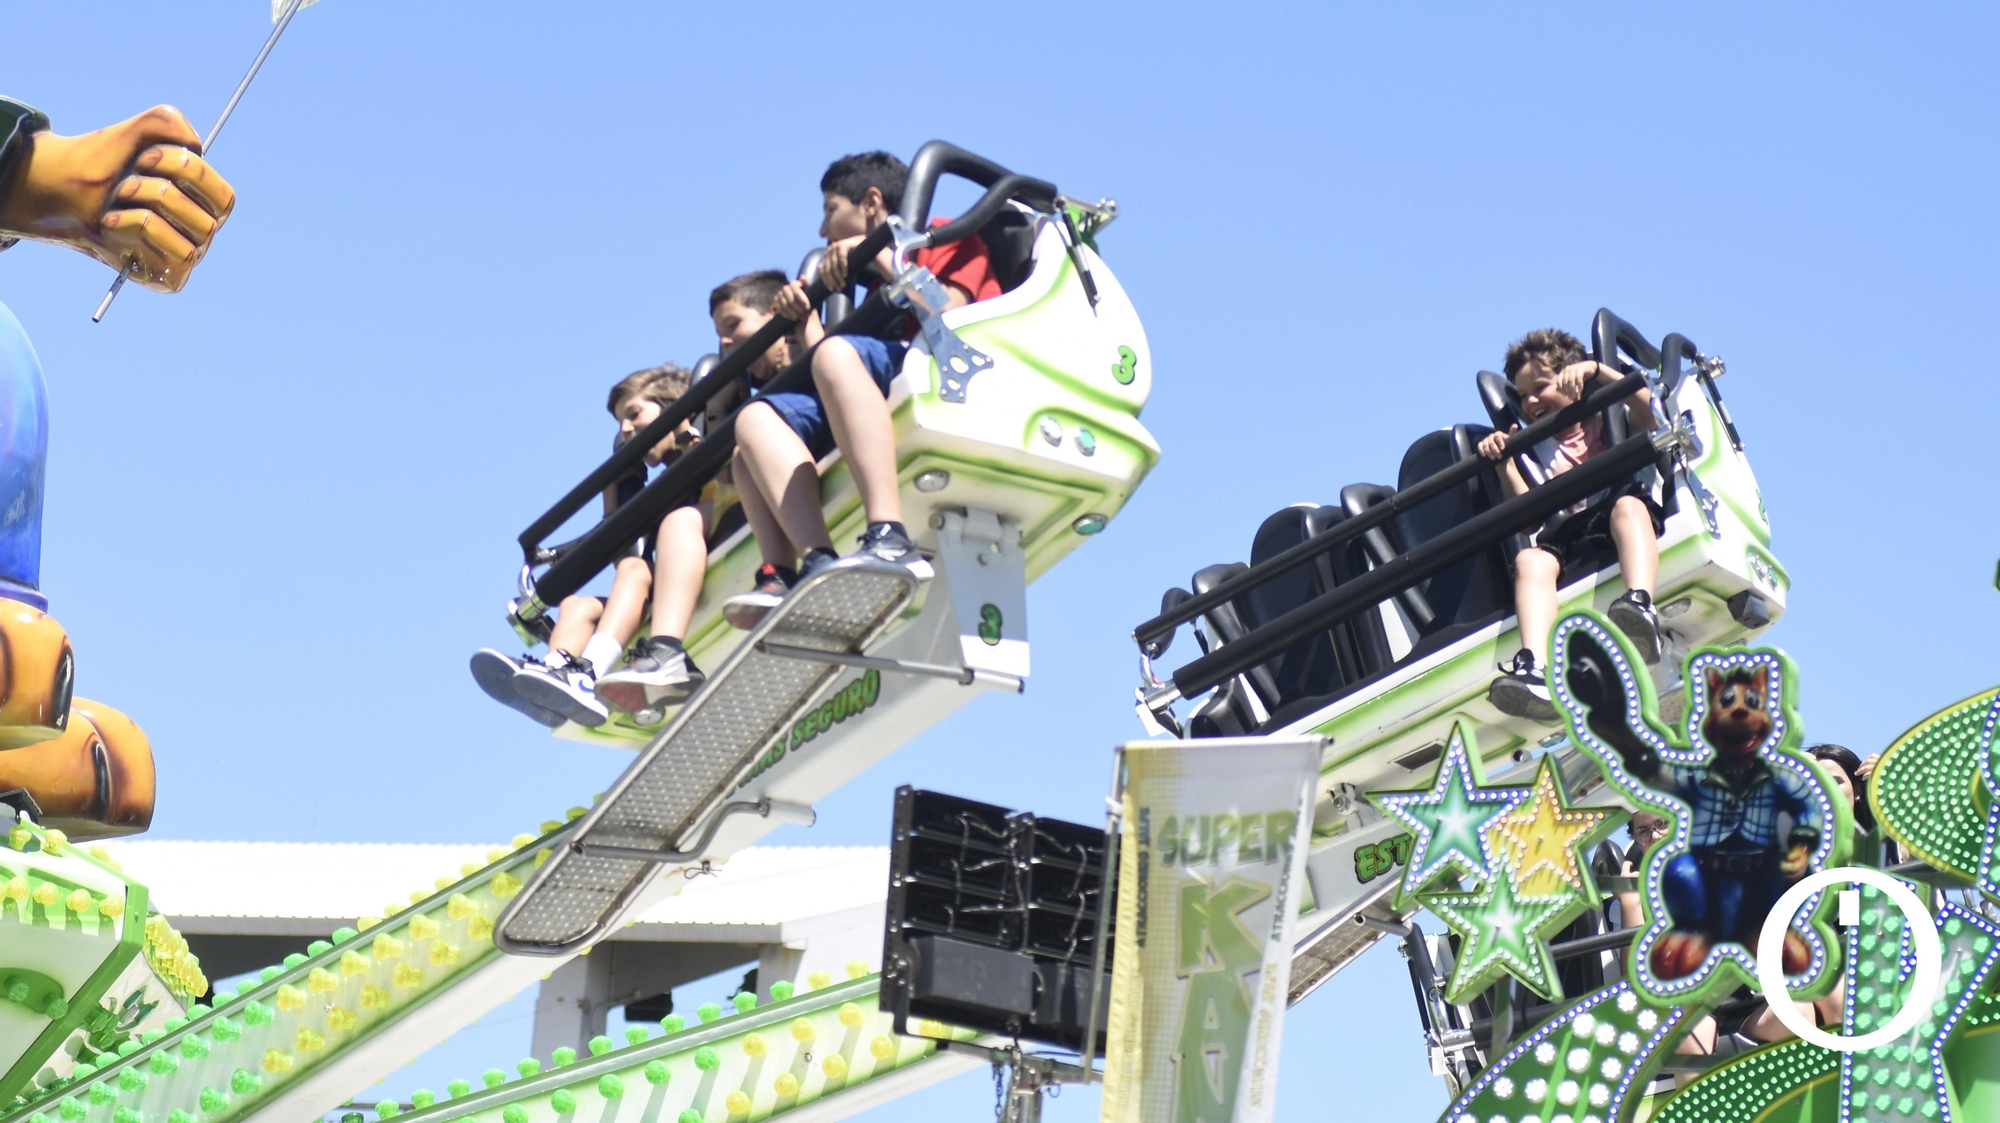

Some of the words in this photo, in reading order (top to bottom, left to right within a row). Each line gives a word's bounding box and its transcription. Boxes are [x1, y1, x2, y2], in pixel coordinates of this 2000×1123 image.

[1111, 345, 1137, 385] 3
[978, 603, 1003, 646] 3
[790, 669, 881, 752] SEGURO
[1157, 810, 1297, 867] SUPER
